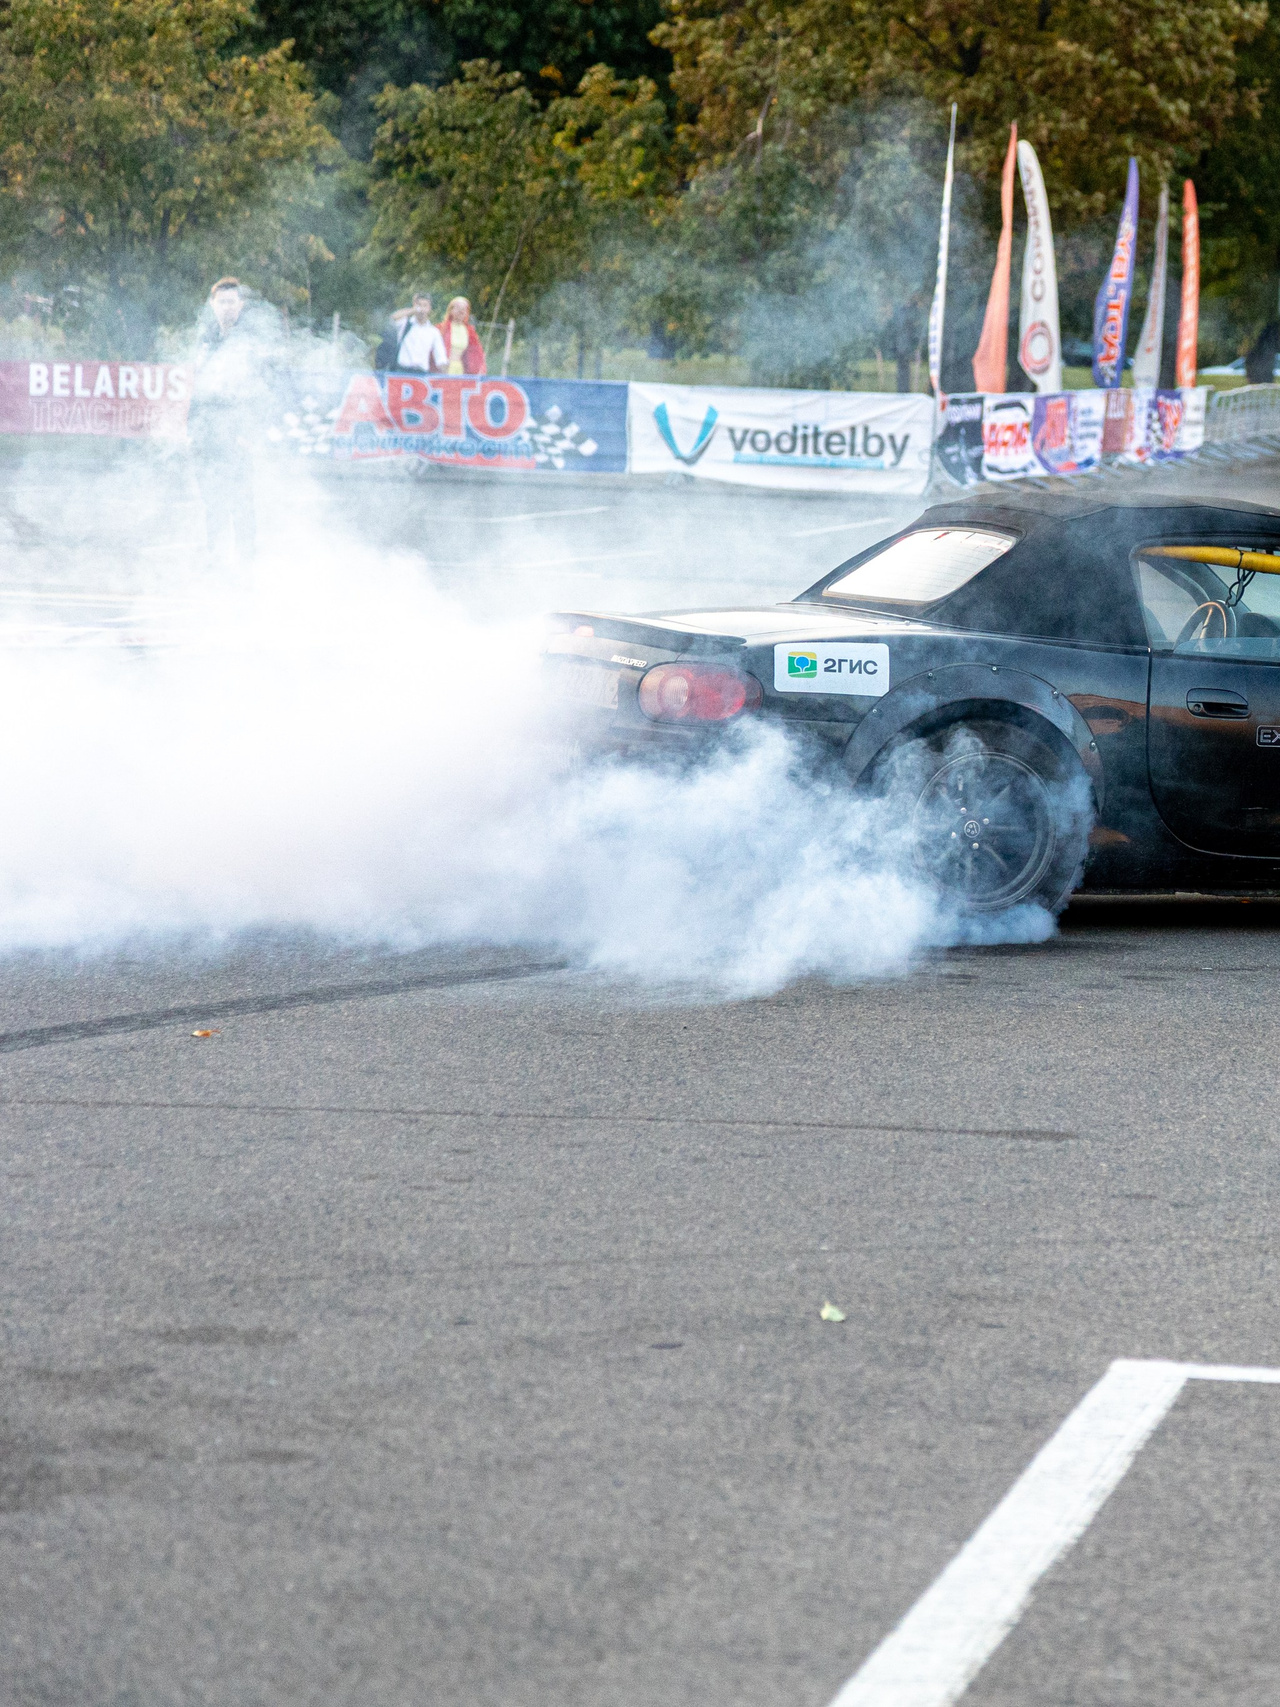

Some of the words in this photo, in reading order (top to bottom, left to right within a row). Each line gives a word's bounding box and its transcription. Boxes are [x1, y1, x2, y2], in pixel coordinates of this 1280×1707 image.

[28, 362, 187, 400] BELARUS
[333, 374, 527, 438] АВТО
[823, 658, 878, 675] 2ГИС
